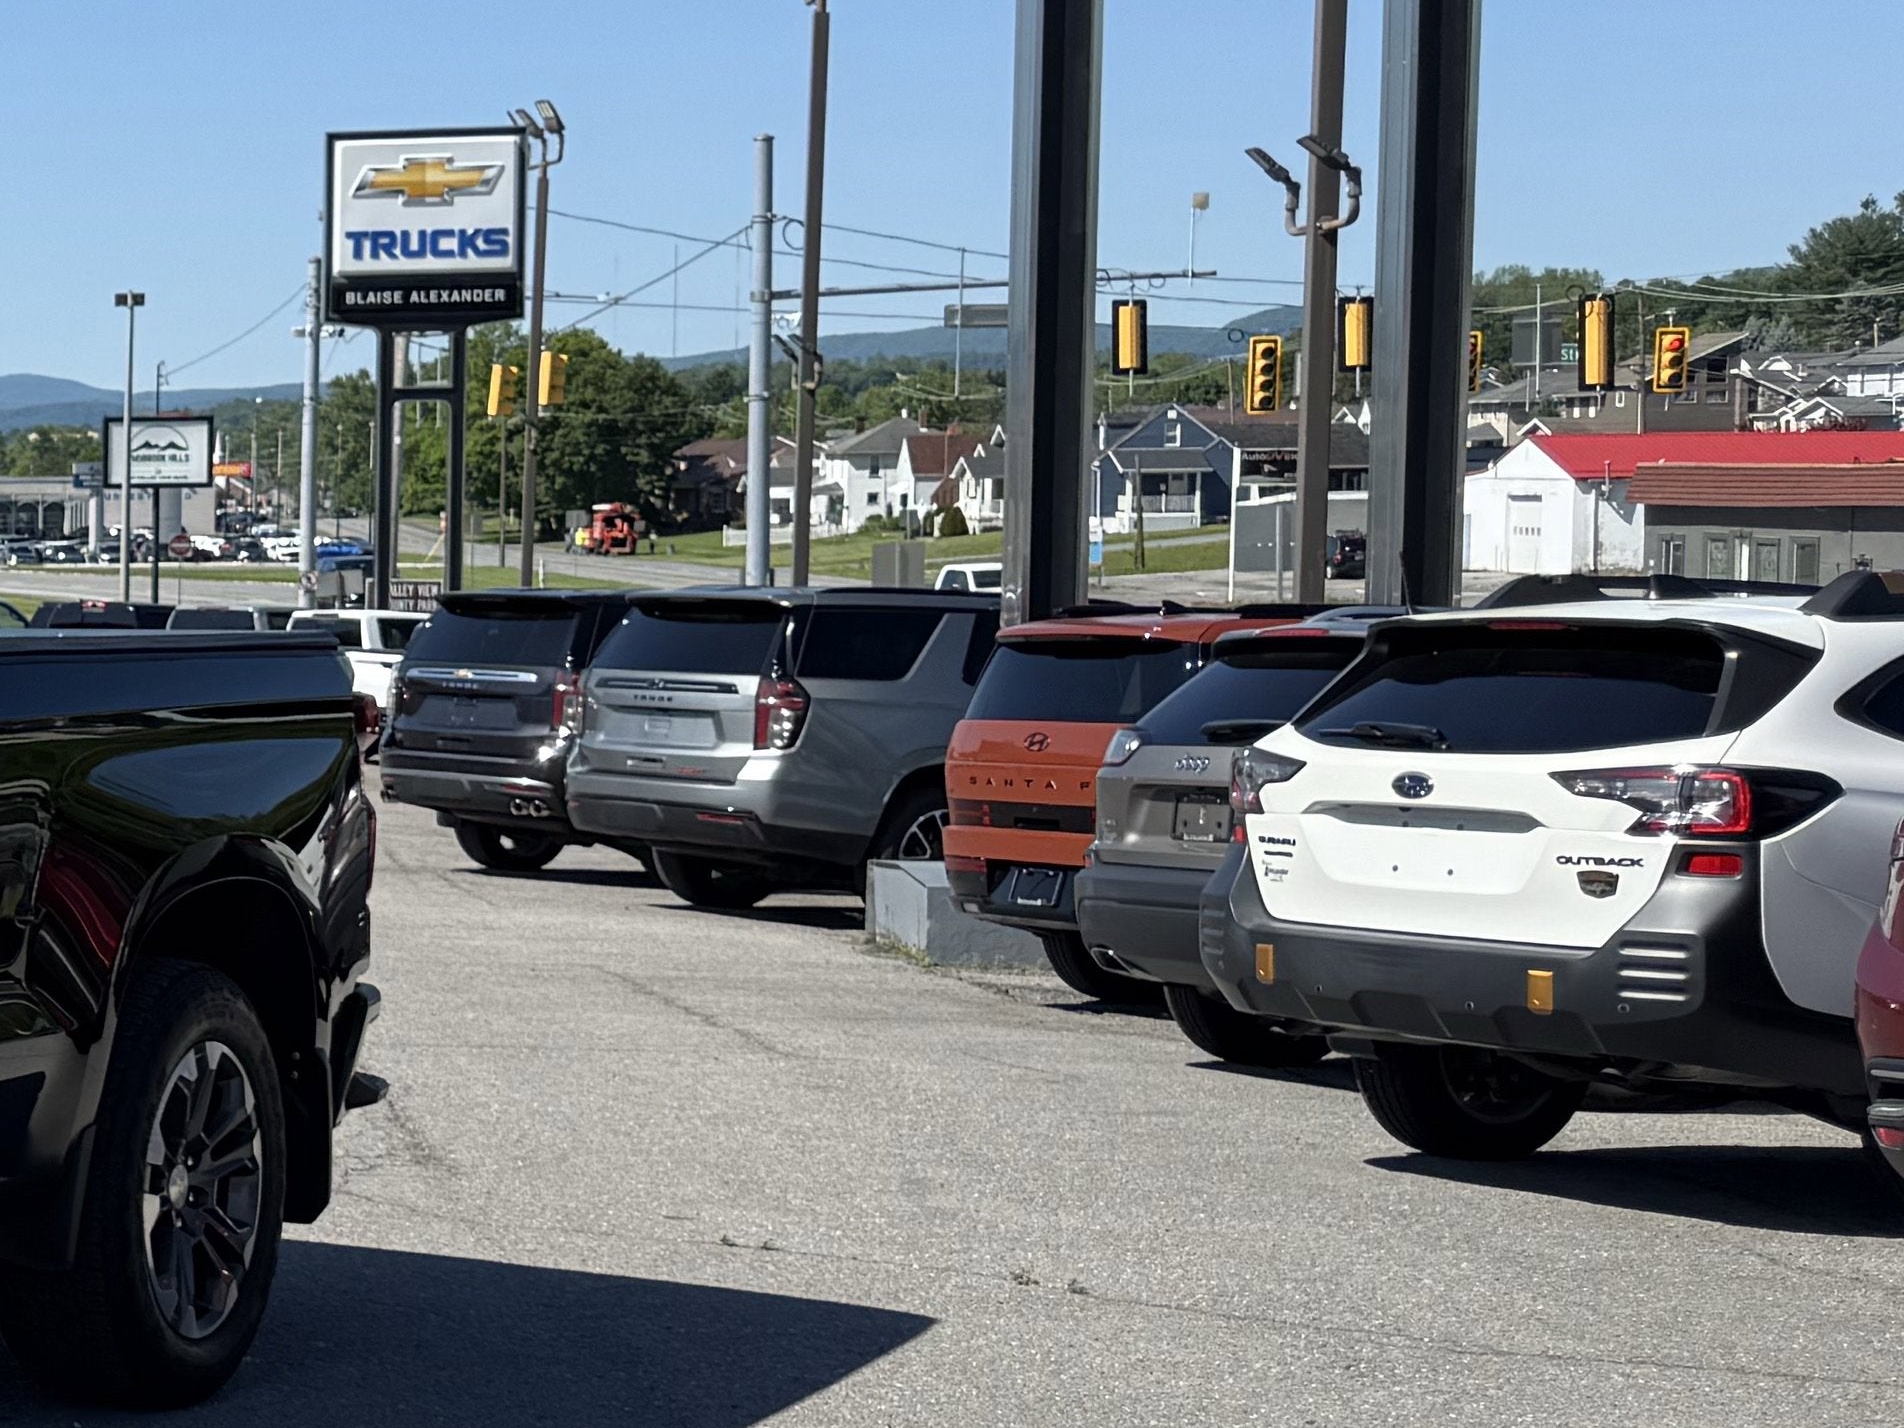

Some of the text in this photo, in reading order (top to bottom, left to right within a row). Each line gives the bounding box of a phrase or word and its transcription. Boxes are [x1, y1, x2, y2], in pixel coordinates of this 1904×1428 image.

[344, 227, 511, 261] TRUCKS
[345, 288, 506, 305] BLAISE ALEXANDER
[969, 776, 1057, 790] SANTA
[1556, 855, 1644, 868] OUTBACK
